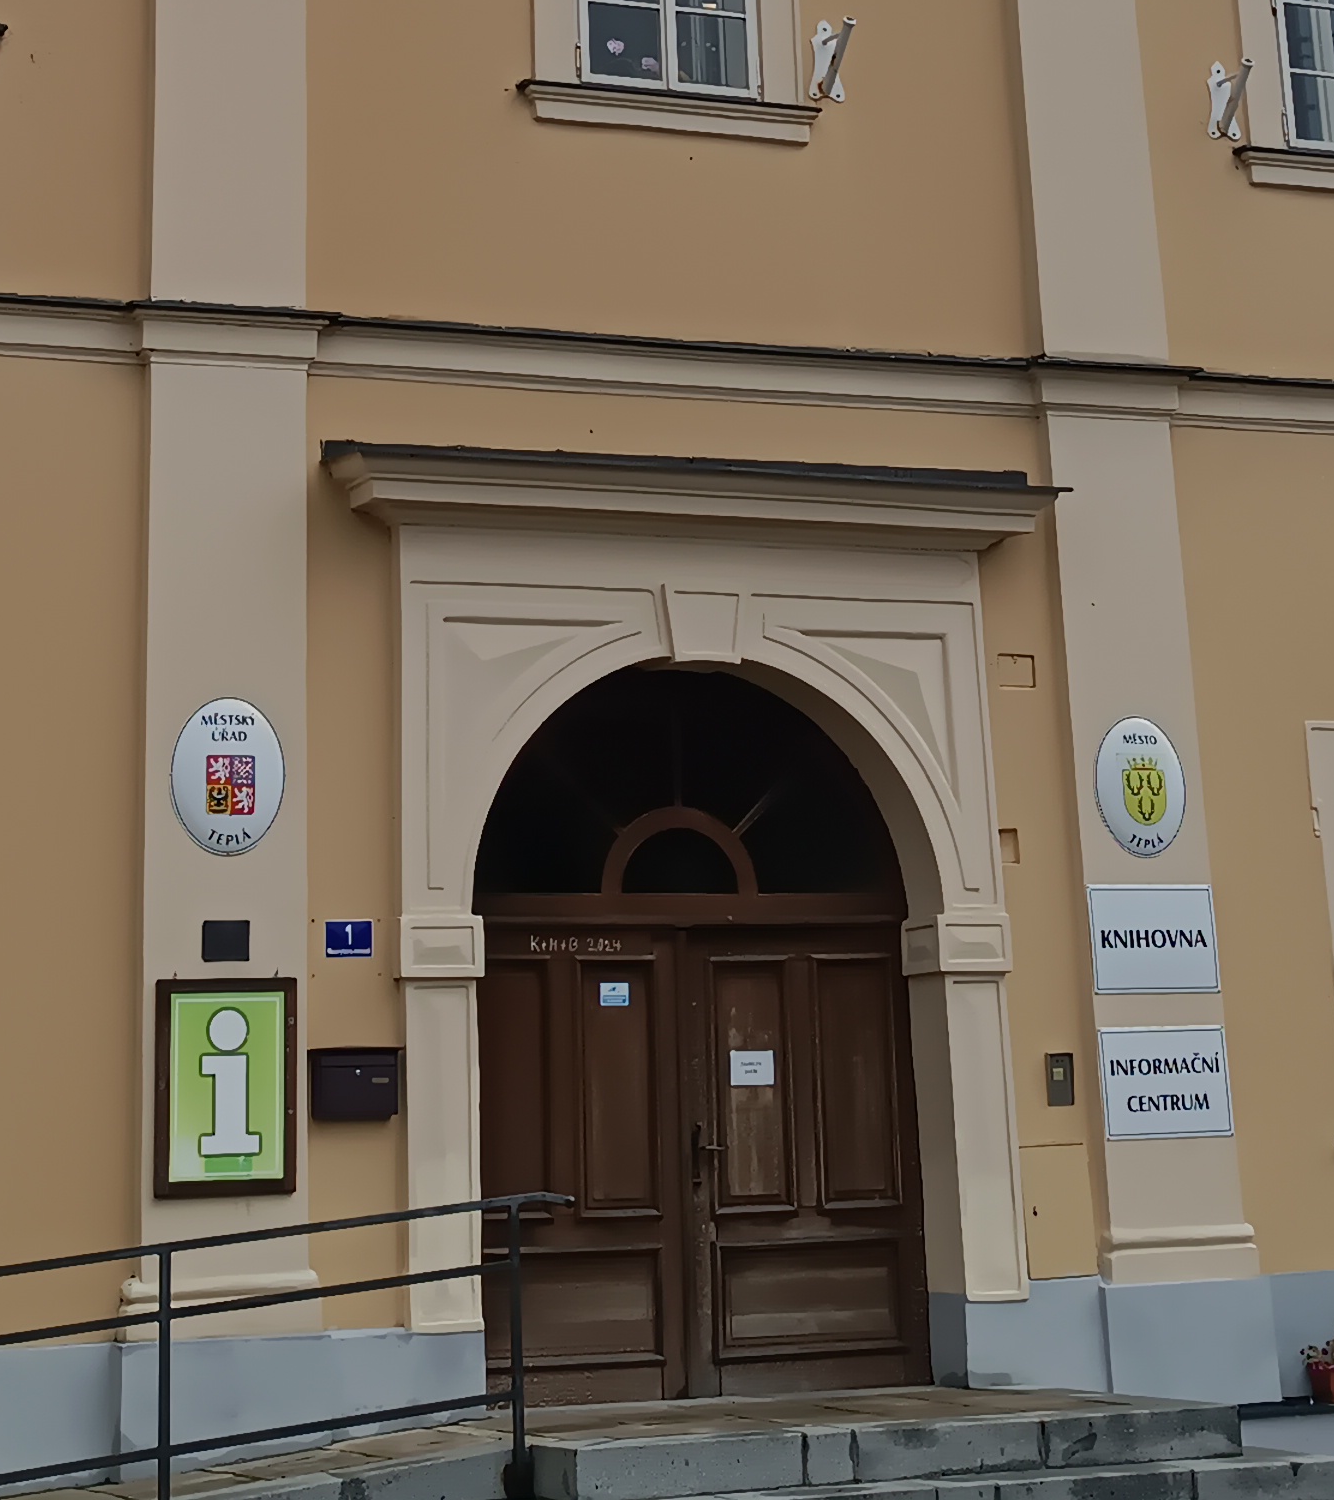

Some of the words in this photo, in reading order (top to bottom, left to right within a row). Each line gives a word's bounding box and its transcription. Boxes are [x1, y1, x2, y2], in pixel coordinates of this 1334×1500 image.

[200, 712, 256, 726] MĚSTSKÝ
[211, 727, 248, 742] ÚŘAD
[1122, 733, 1158, 745] MĚSTO
[208, 827, 252, 846] TEPLÁ
[1129, 832, 1164, 849] TEPLÁ
[344, 923, 353, 946] 1
[1100, 928, 1208, 949] KNIHOVNA
[586, 938, 622, 952] 2024
[1109, 1051, 1220, 1077] INFORMAČNÍ
[1126, 1092, 1210, 1113] CENTRUM
